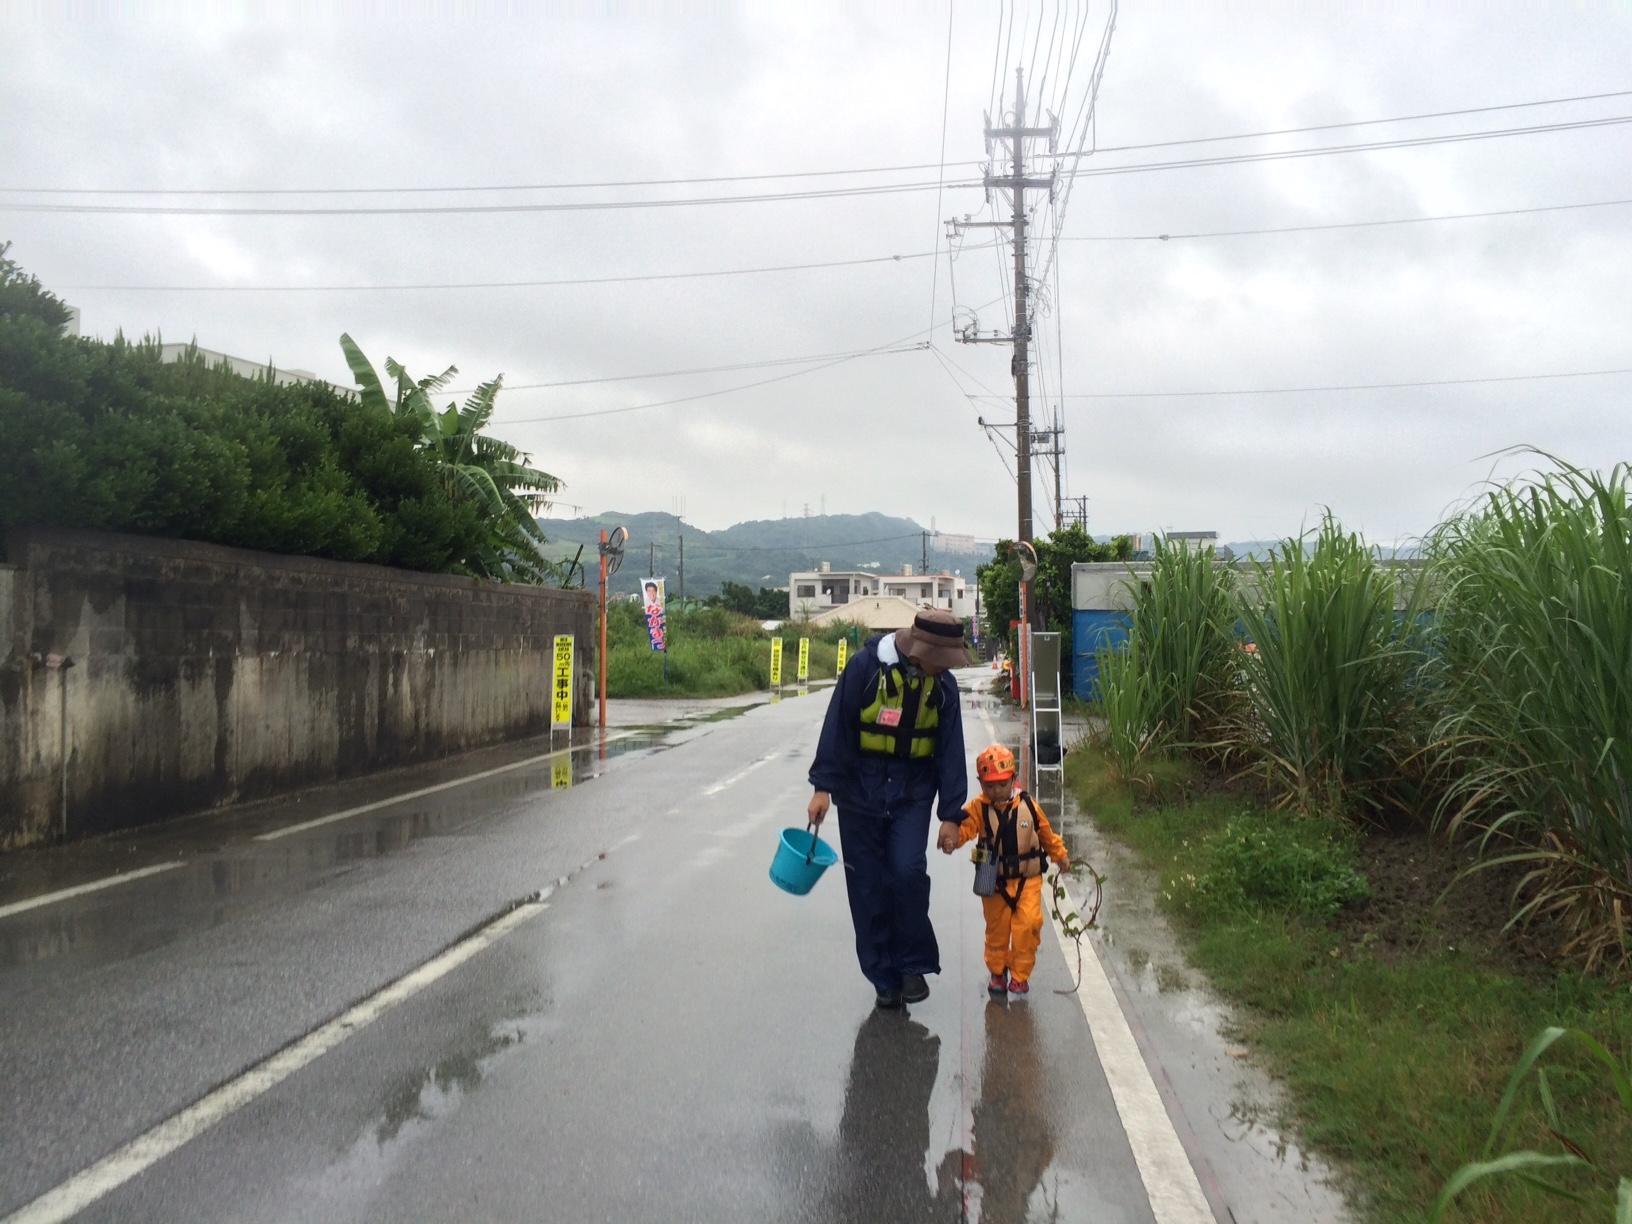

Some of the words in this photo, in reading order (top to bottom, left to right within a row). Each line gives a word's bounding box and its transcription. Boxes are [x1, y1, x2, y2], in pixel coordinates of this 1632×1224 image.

[557, 653, 571, 661] 50
[556, 667, 569, 700] 工事中
